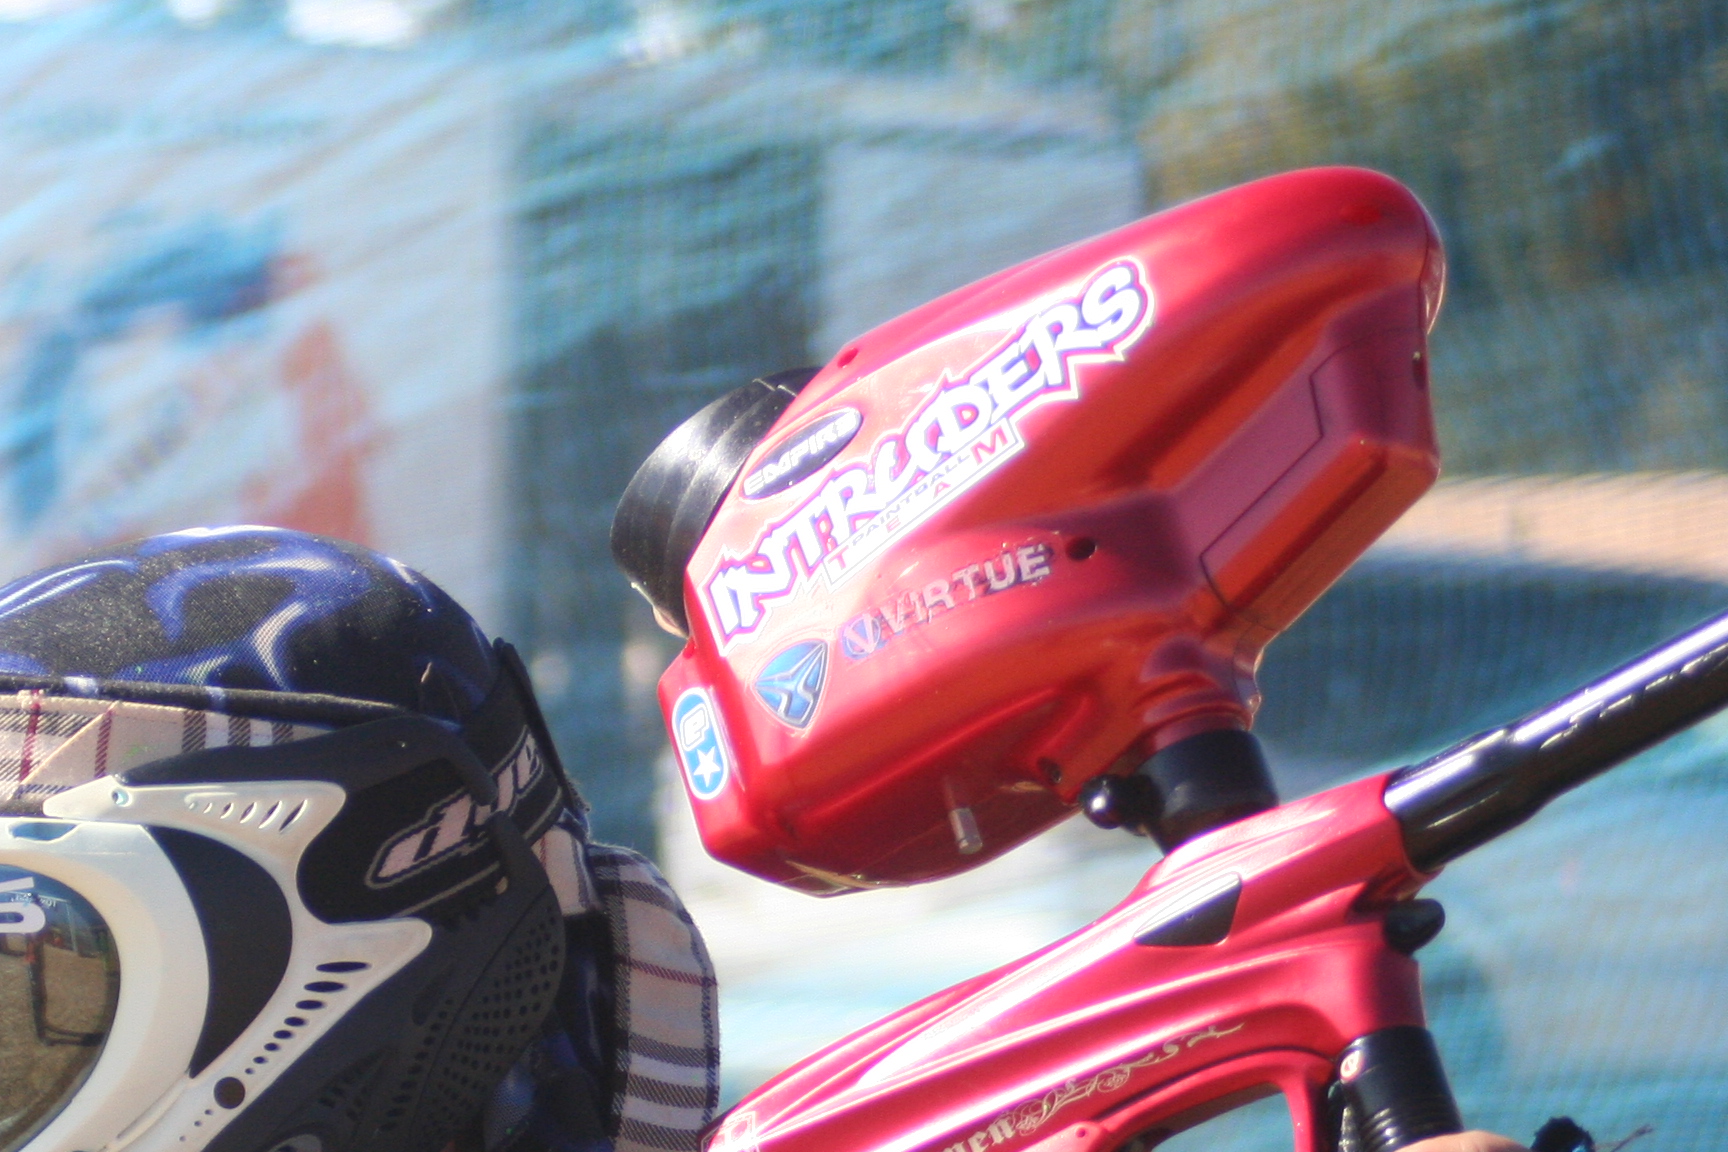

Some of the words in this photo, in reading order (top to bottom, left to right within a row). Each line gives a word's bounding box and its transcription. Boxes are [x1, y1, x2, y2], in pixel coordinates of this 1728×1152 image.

[705, 262, 1146, 642] INTRUDERS
[742, 410, 859, 498] EMPIRE
[878, 542, 1052, 636] VIRTUE
